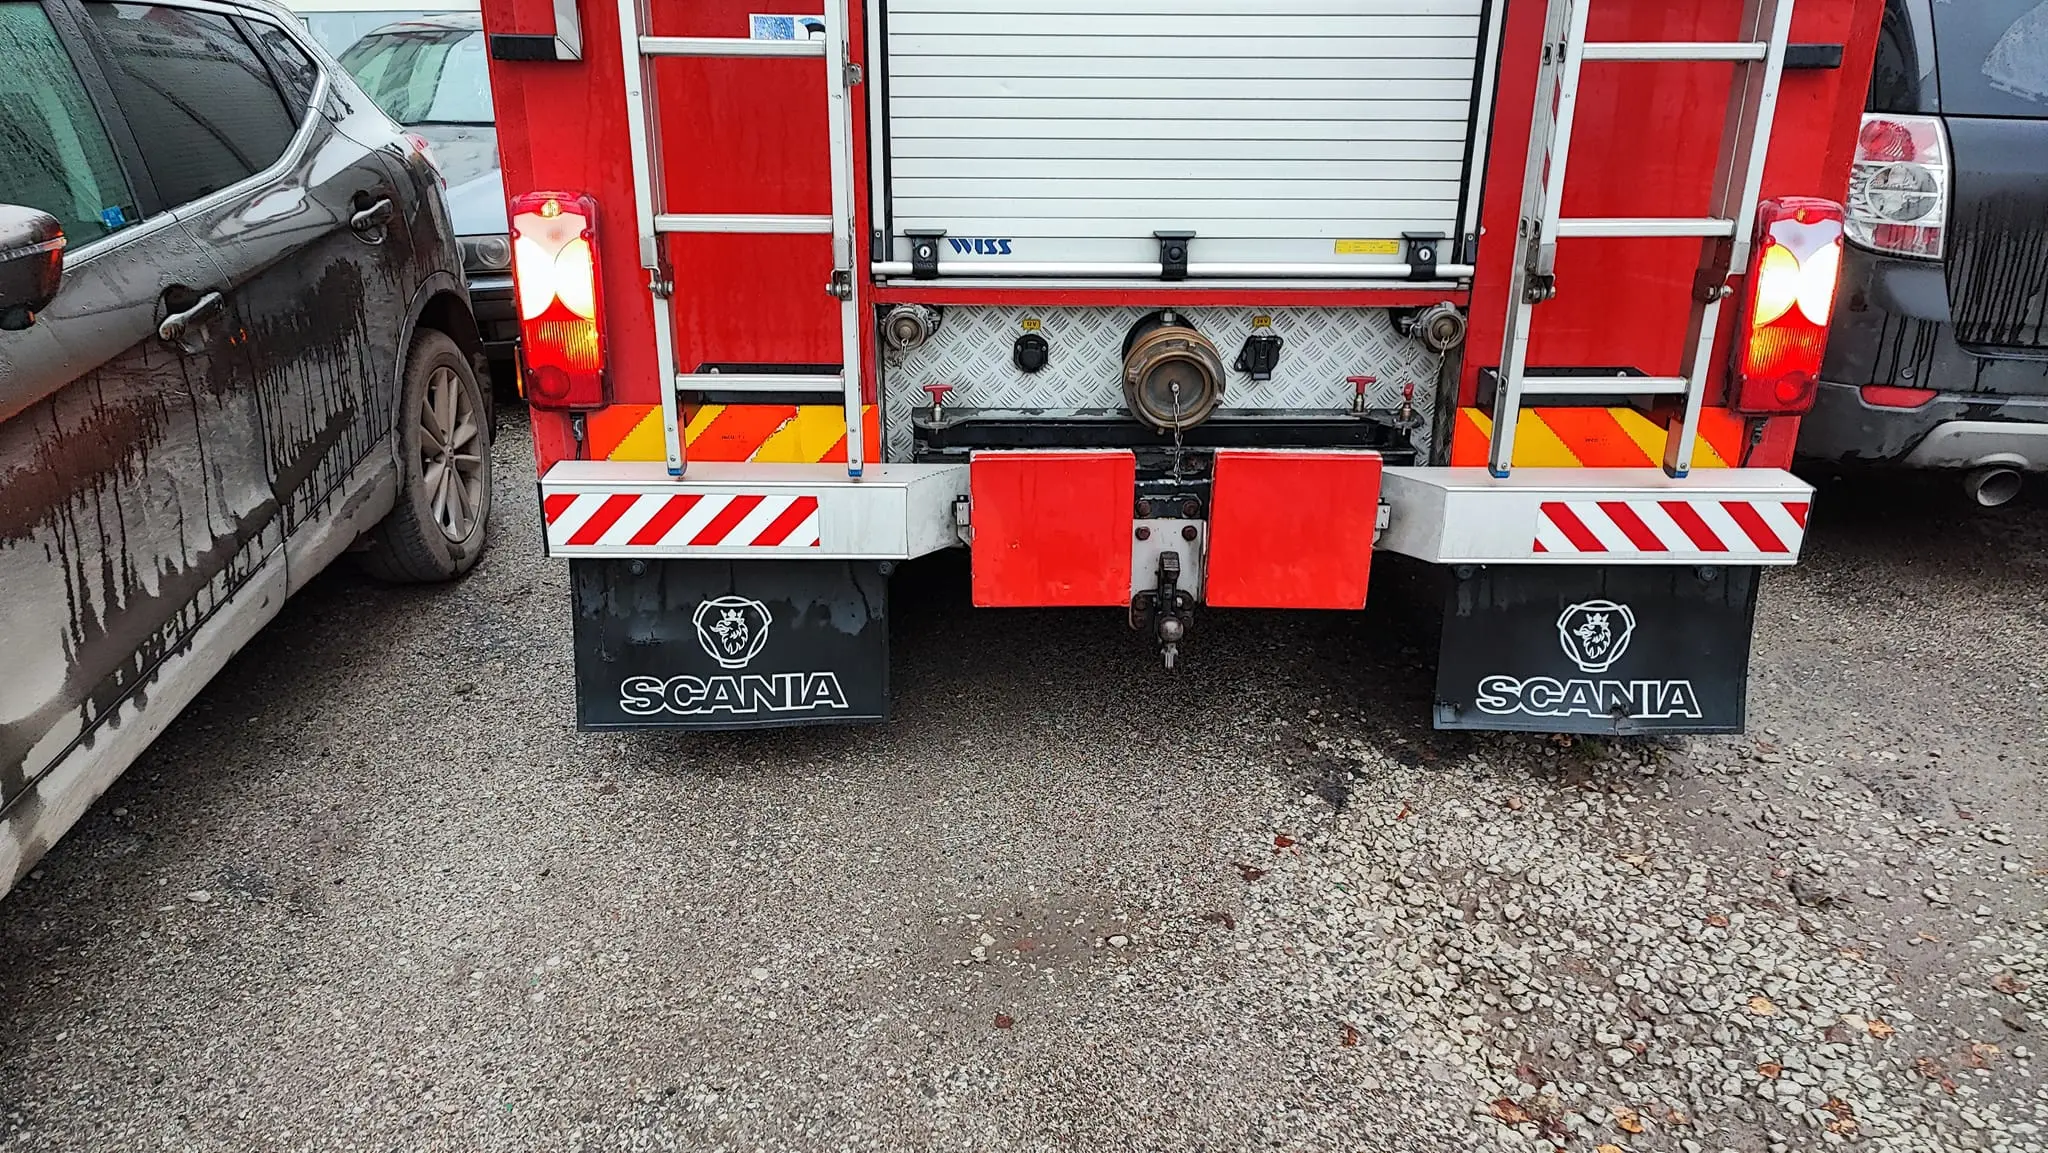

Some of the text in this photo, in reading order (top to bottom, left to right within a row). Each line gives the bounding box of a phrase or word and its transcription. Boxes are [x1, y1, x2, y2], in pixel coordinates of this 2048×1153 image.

[947, 238, 1012, 255] WISS
[619, 671, 849, 715] SCANIA
[1475, 675, 1703, 719] SCANIA
